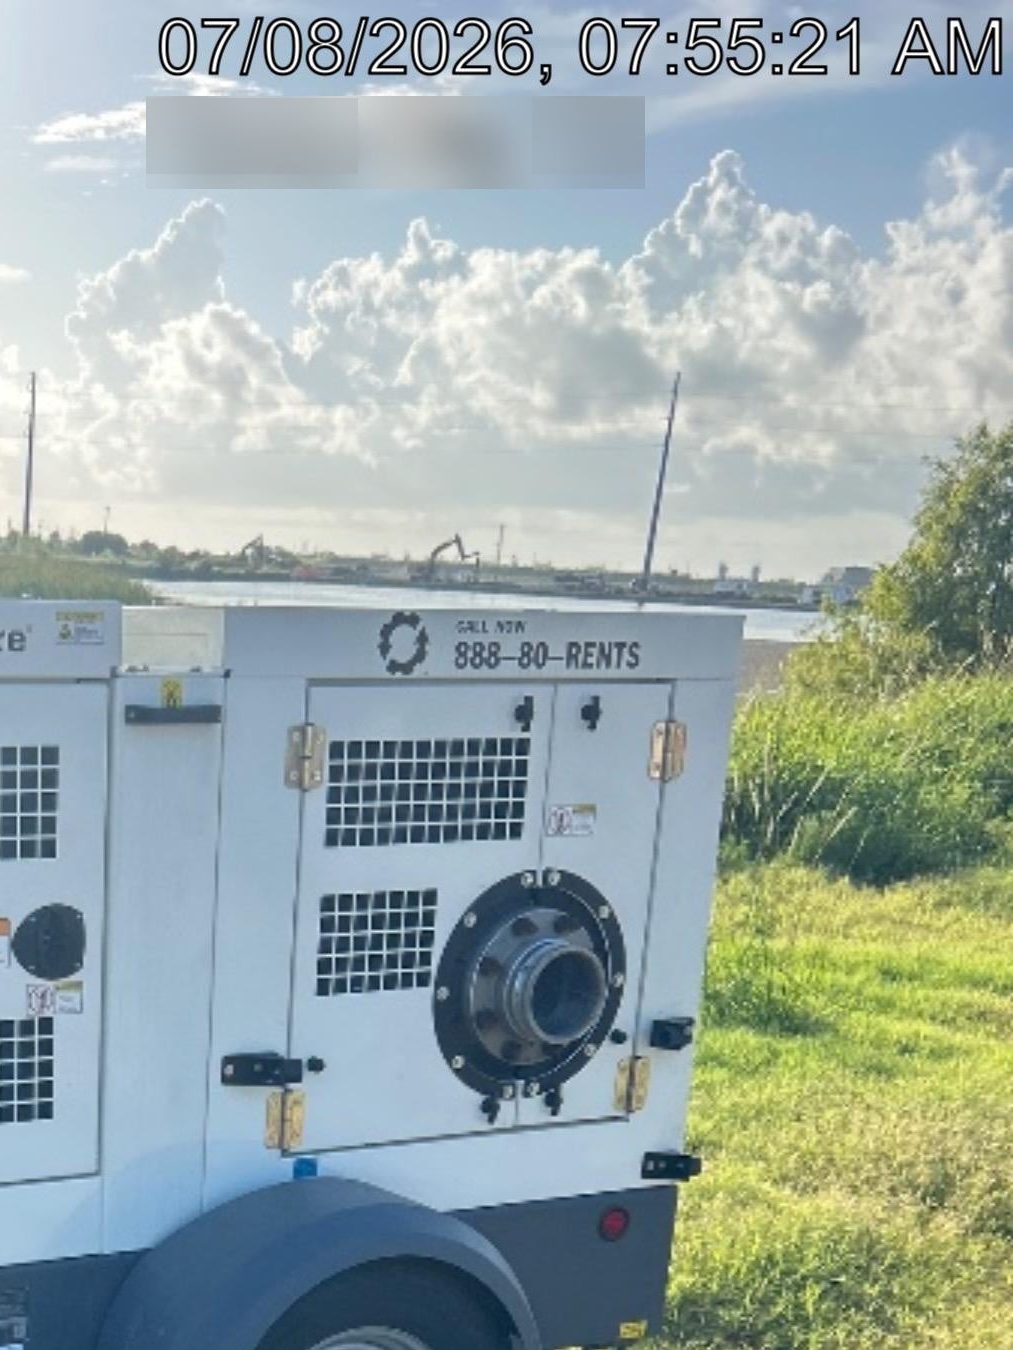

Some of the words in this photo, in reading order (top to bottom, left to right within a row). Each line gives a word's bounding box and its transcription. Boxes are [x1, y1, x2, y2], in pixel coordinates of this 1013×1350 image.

[457, 620, 489, 634] CALL
[495, 620, 527, 634] NOW
[454, 641, 641, 670] 888-80-RENTS
